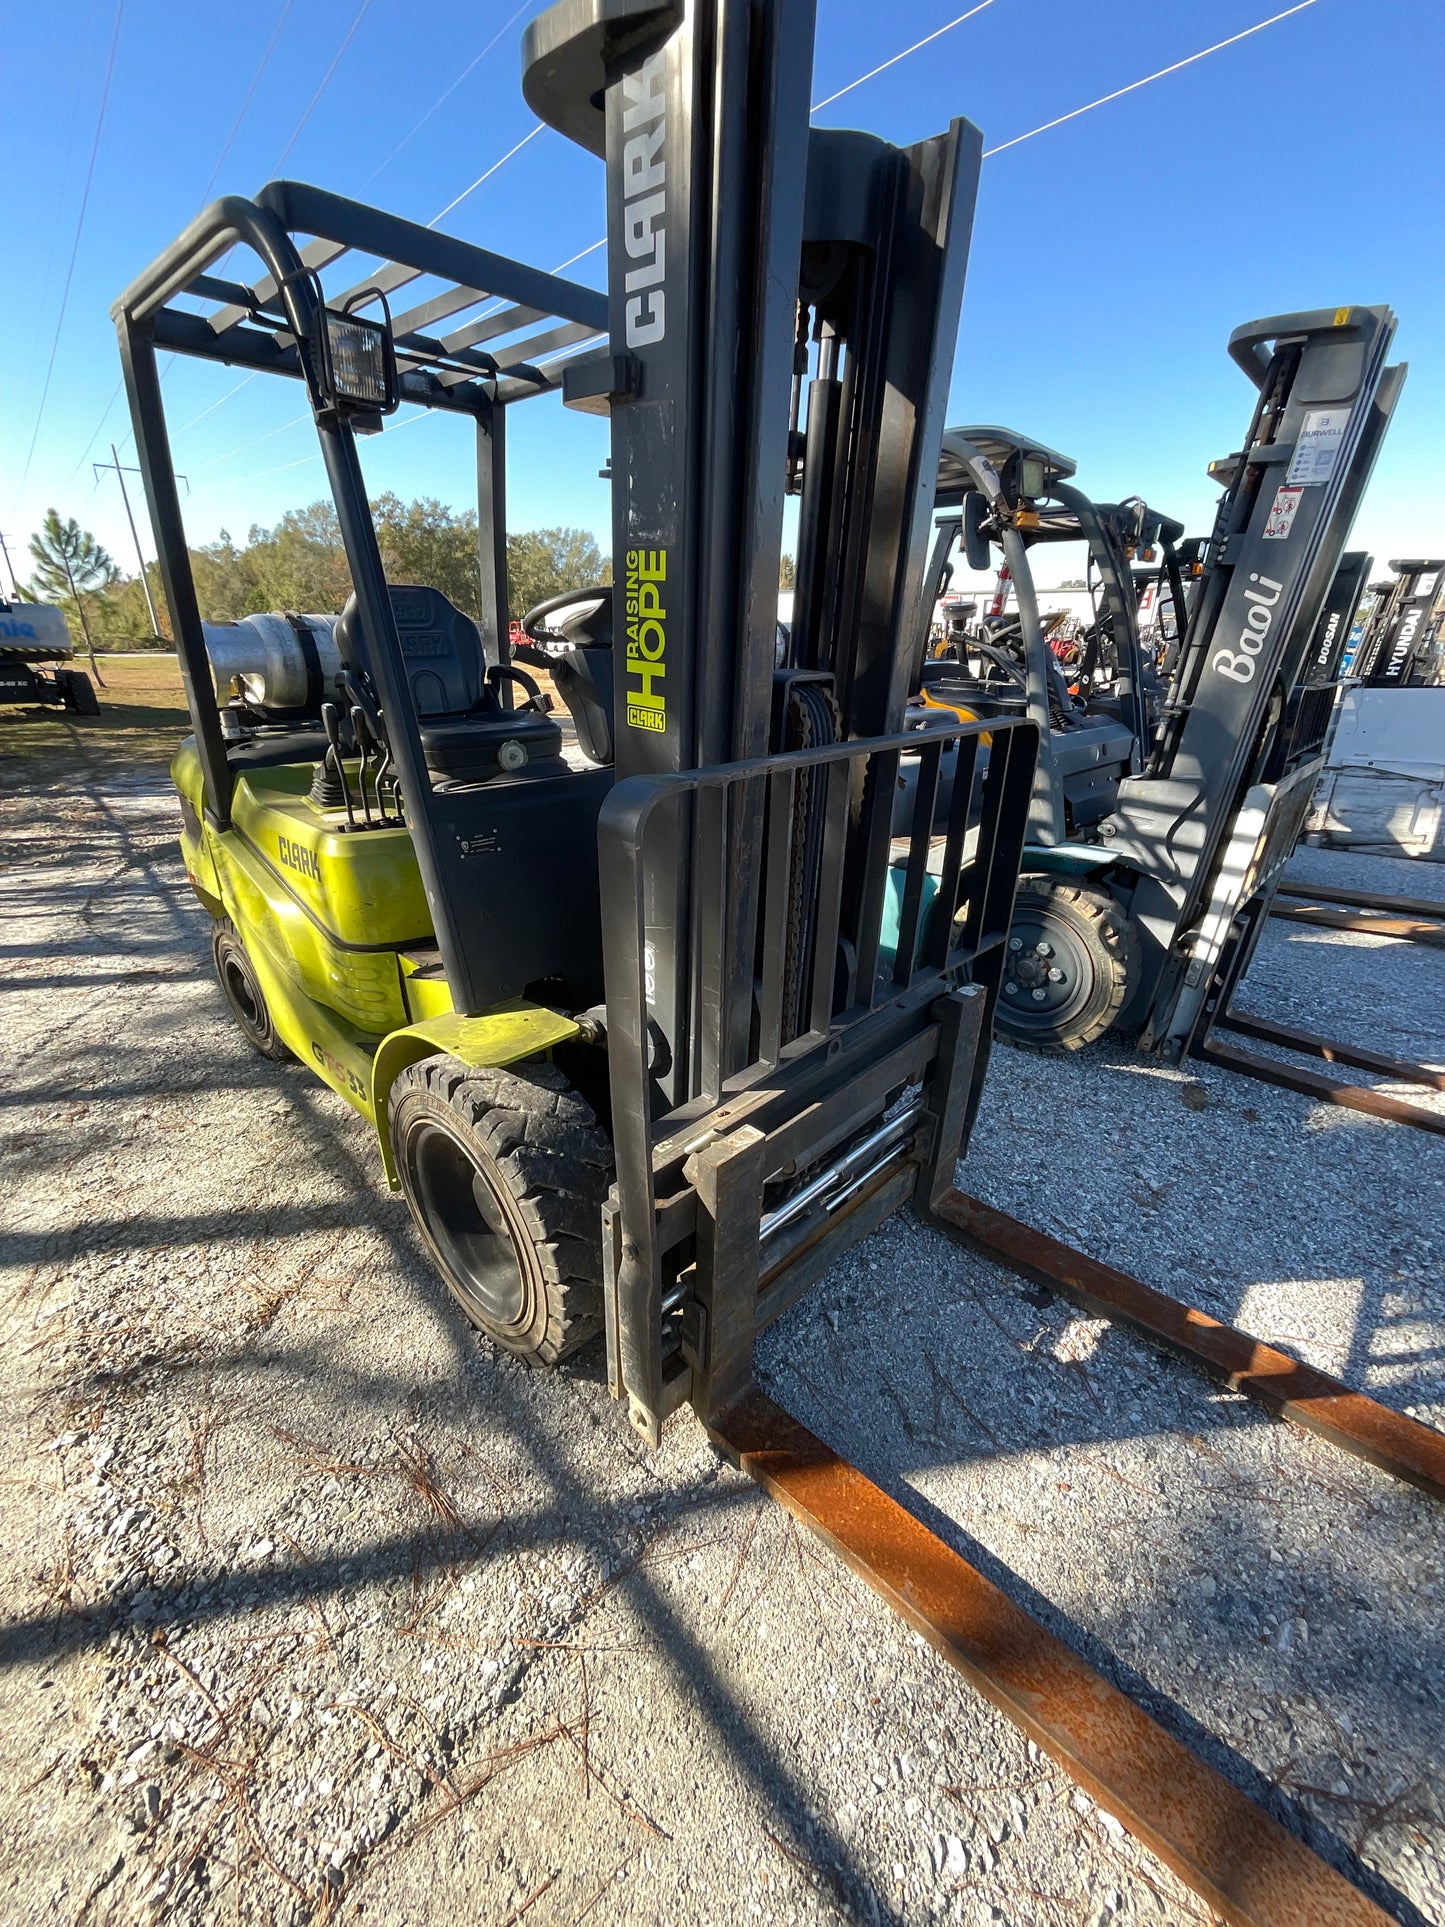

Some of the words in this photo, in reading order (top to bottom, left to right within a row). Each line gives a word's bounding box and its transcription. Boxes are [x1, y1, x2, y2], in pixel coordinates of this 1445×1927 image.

[622, 49, 666, 349] CLARK
[625, 549, 639, 658] RAISING
[626, 549, 667, 711] HOPE
[1212, 572, 1284, 684] Baoli
[1318, 612, 1341, 665] DOOSAN
[1385, 608, 1423, 676] HYUNDAI
[629, 708, 664, 731] CLARK
[278, 835, 322, 883] CLARK
